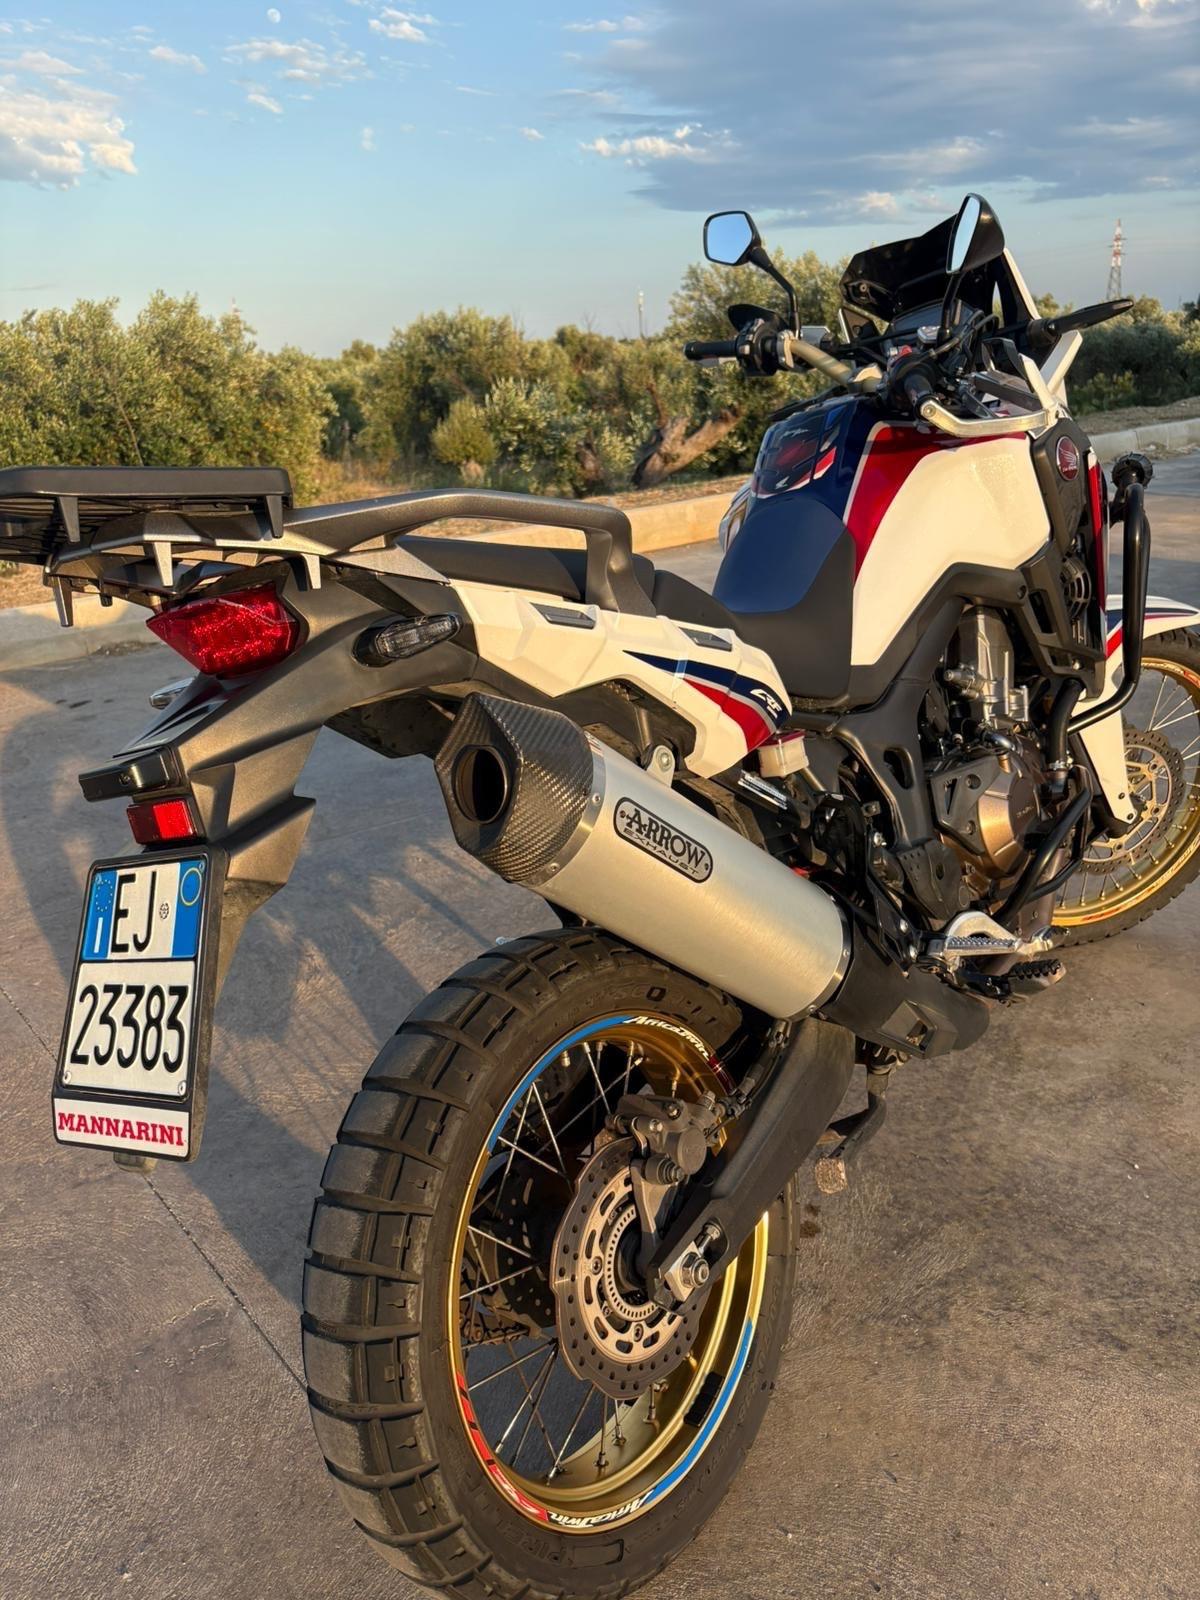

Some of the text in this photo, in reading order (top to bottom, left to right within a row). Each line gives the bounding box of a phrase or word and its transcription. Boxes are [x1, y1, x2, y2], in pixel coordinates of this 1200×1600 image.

[622, 827, 700, 875] EXHAUST
[625, 807, 706, 869] ARROW
[111, 870, 158, 953] EJ
[69, 983, 190, 1074] 23383
[57, 1111, 186, 1147] MANNARINI
